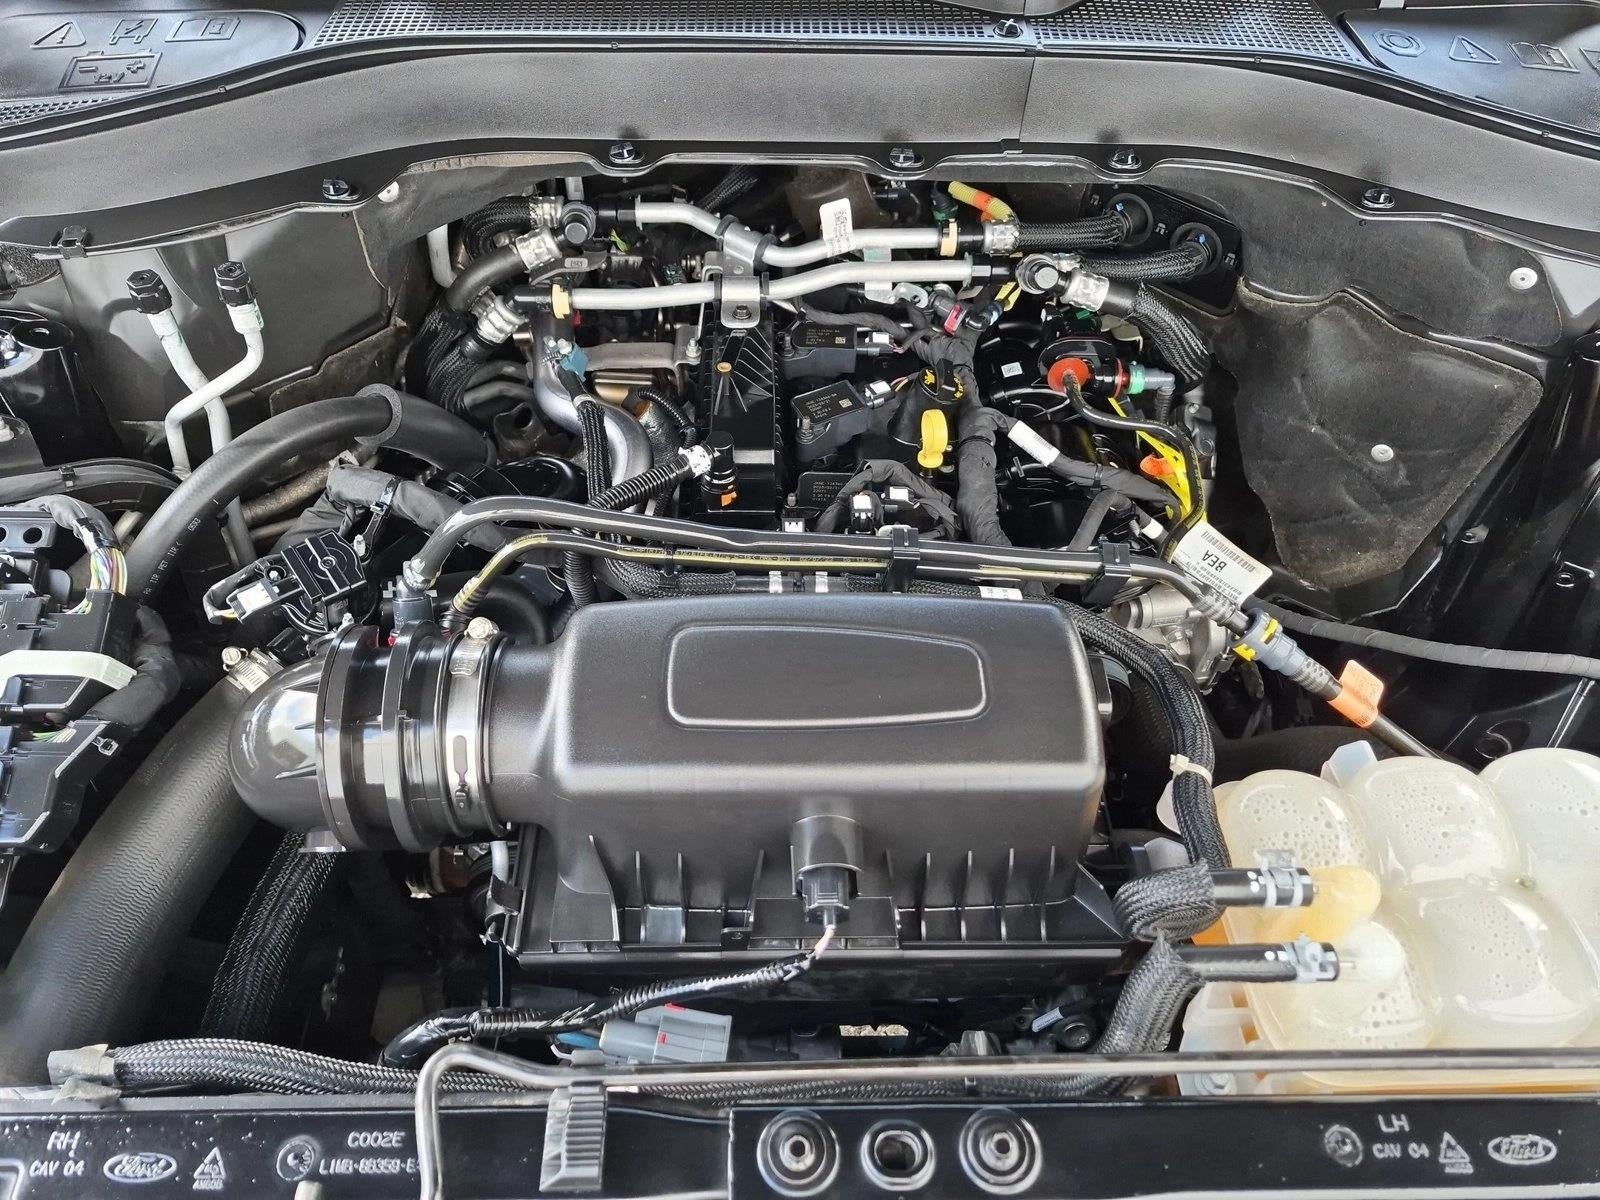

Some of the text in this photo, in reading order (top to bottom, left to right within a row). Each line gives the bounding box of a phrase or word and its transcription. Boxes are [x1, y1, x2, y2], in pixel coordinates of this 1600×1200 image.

[1201, 549, 1228, 573] BEA
[1377, 1113, 1410, 1133] LH
[46, 1130, 81, 1151] RH
[1372, 1143, 1401, 1159] CAV
[1408, 1143, 1429, 1159] 04
[29, 1159, 85, 1177] CAV 04
